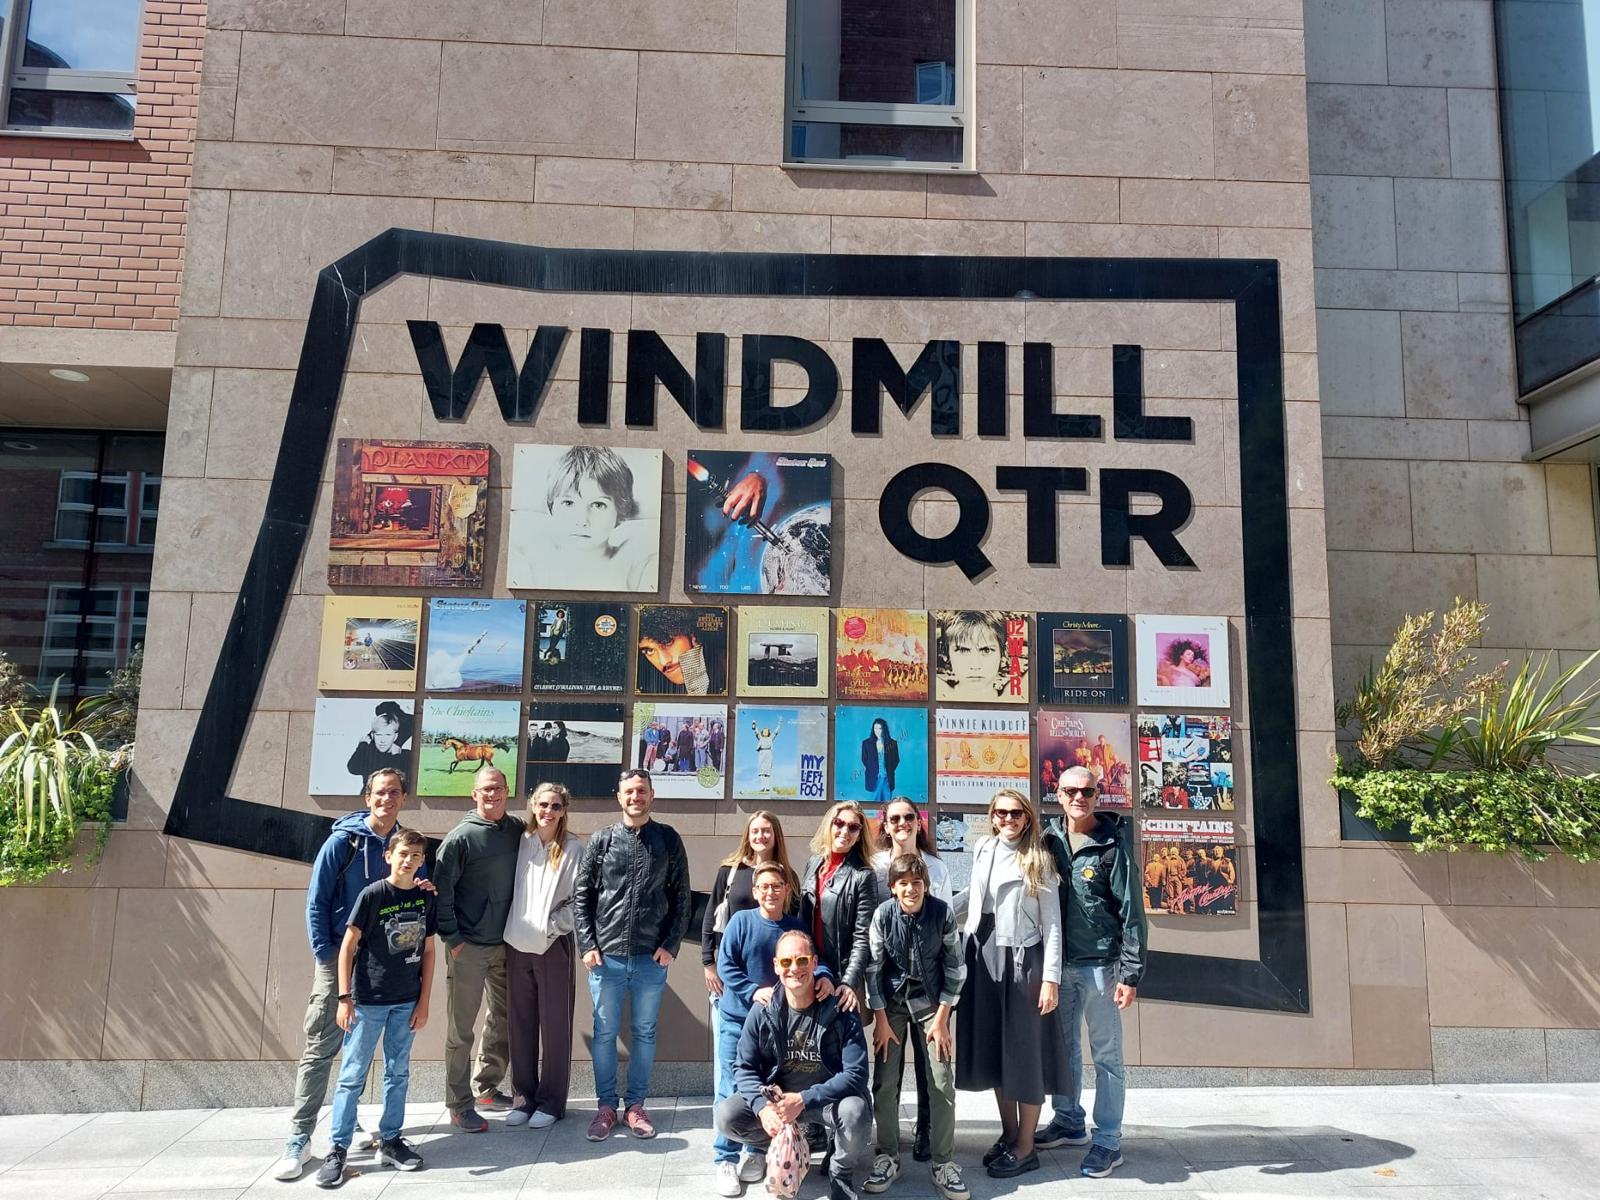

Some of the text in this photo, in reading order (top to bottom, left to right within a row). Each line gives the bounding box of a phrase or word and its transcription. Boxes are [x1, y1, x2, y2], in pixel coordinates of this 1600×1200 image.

[407, 320, 1193, 441] WINDMILL
[879, 462, 1198, 584] QTR
[1007, 637, 1025, 696] WAR
[1064, 689, 1106, 698] RIDE ON
[446, 703, 496, 719] Chieftains
[938, 718, 977, 730] VINNIE
[800, 753, 825, 770] MY
[1146, 819, 1234, 834] CHIEFTAINS
[786, 1039, 795, 1047] 17
